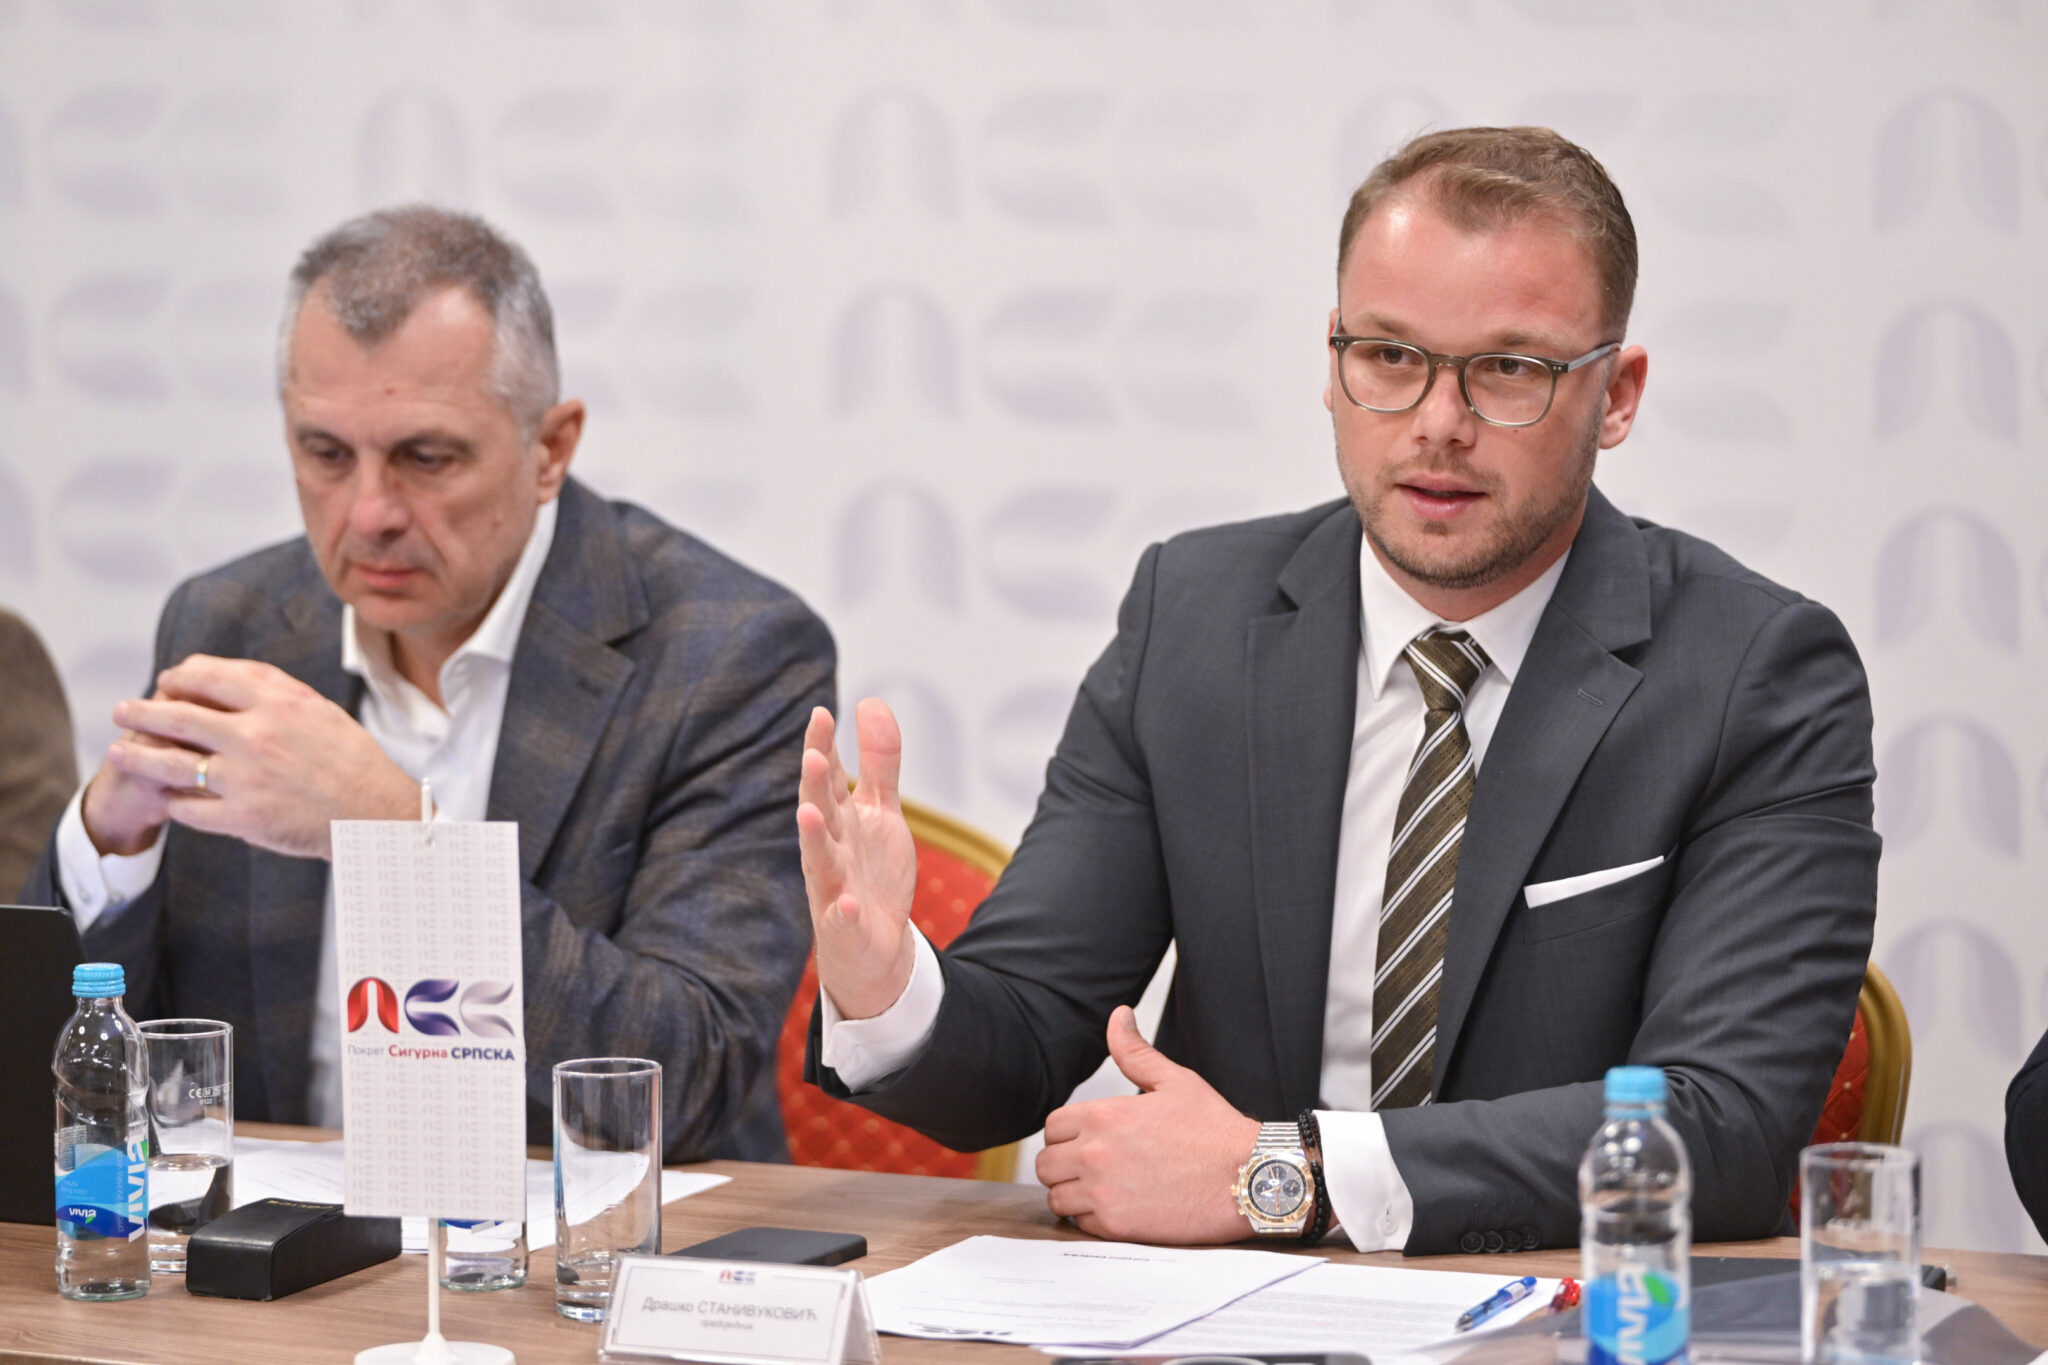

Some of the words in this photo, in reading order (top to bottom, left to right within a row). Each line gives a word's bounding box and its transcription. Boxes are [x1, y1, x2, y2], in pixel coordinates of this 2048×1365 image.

[347, 1044, 385, 1056] Покрет
[389, 1044, 448, 1060] Сигурна
[451, 1046, 516, 1061] СРПСКА
[642, 1296, 694, 1313] Драшко
[698, 1300, 818, 1322] СТАНИВУКОВИЋ
